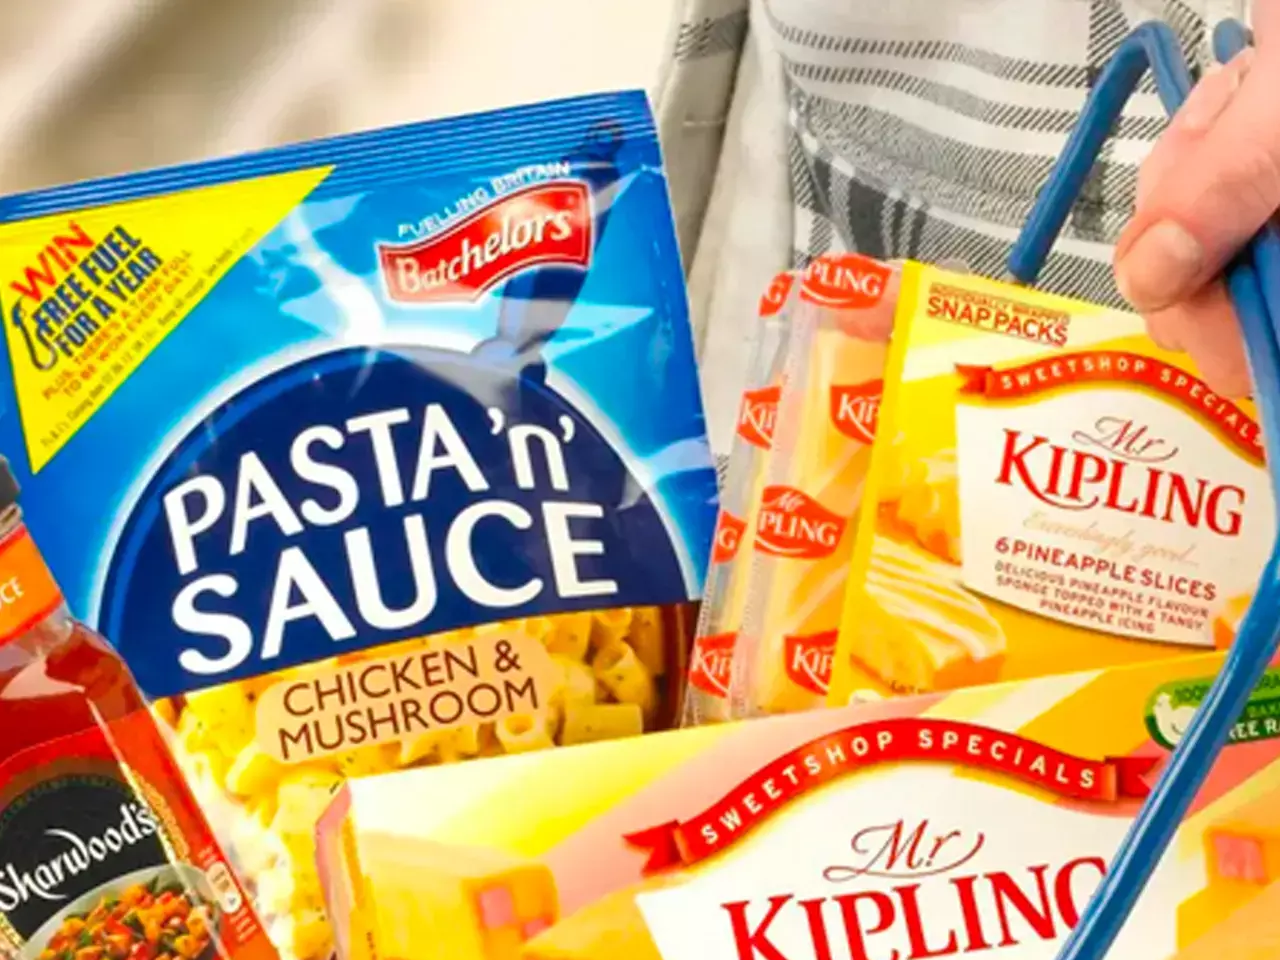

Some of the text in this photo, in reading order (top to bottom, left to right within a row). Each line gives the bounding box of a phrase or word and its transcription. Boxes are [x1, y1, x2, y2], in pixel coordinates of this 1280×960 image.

[398, 161, 572, 239] FUELLING BRITAIN
[10, 220, 95, 303] WIN
[31, 273, 92, 337] FREE
[78, 225, 142, 288] FUEL
[396, 210, 573, 293] Batchelors
[806, 260, 882, 297] PLING
[53, 310, 101, 358] FOR
[90, 295, 116, 321] A
[104, 246, 163, 302] YEAR
[927, 296, 1068, 347] SNAP PACKS
[1001, 356, 1265, 449] SWEETSHOP SPECIALS
[1072, 416, 1179, 463] Mr
[163, 403, 489, 575] PASTA
[994, 428, 1246, 538] KIPLING
[758, 510, 839, 547] PLING
[995, 536, 1217, 601] 6 PINEAPPLE SLICES
[172, 500, 619, 675] SAUCE
[994, 560, 1210, 619] DELICIOUS PINEAPPLE FLAVOUR
[996, 574, 1049, 596] SPONGE
[1054, 586, 1105, 608] TOPPED
[1109, 600, 1145, 617] WITH
[1160, 611, 1205, 631] TANGY
[1039, 598, 1156, 634] PINEAPPLE ICING
[283, 638, 523, 717] CHICKEN &
[278, 677, 538, 762] MUSHROOM
[700, 728, 1096, 846] SWEETSHOP SPECIALS
[0, 800, 157, 912] Sharwood's
[822, 818, 985, 884] Mr
